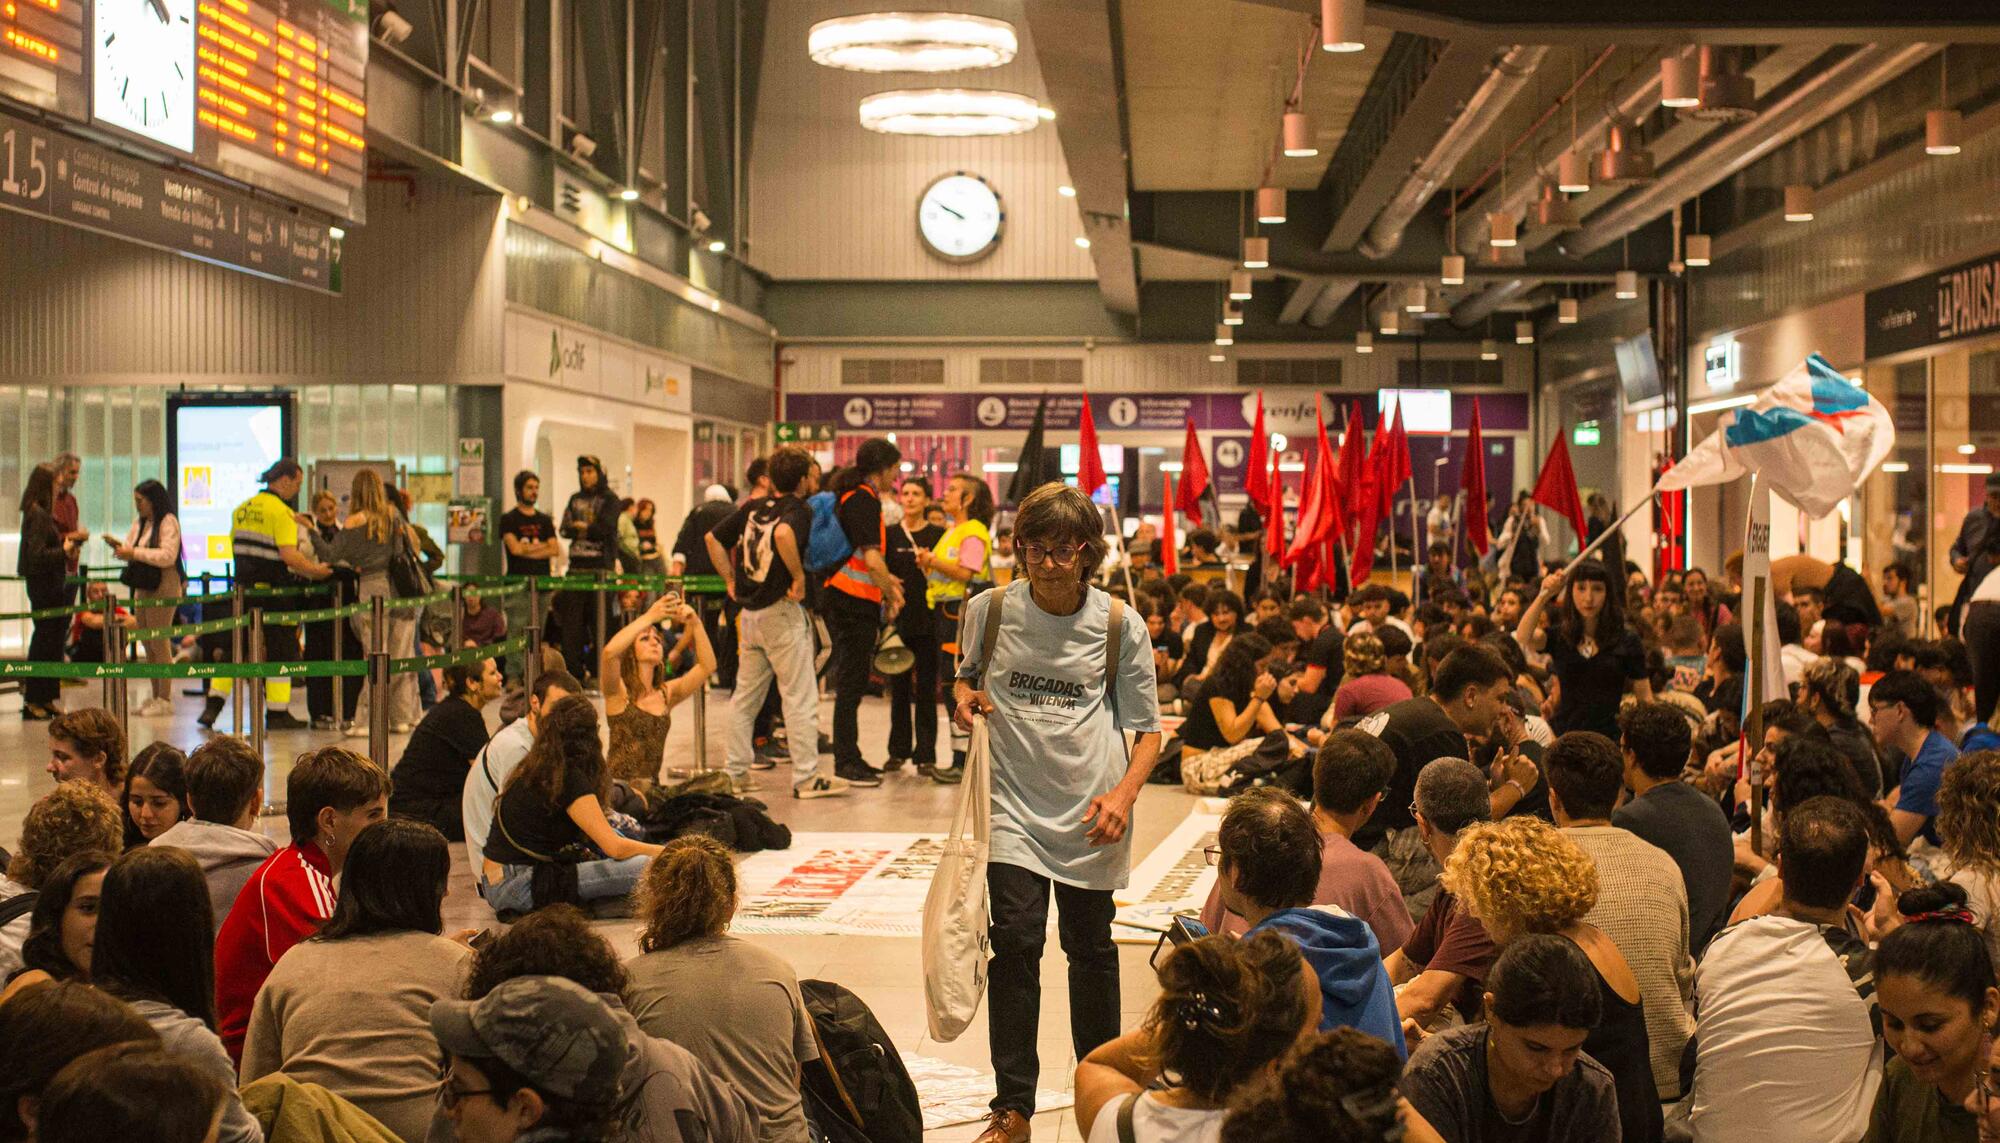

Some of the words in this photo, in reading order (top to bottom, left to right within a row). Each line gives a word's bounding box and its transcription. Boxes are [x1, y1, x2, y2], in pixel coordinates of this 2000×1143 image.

[2, 129, 19, 195] 1
[21, 177, 28, 198] a
[30, 136, 46, 199] 5
[72, 172, 99, 196] Control
[100, 182, 110, 200] de
[1938, 287, 1951, 328] LA
[1009, 671, 1085, 698] BRIGADAS
